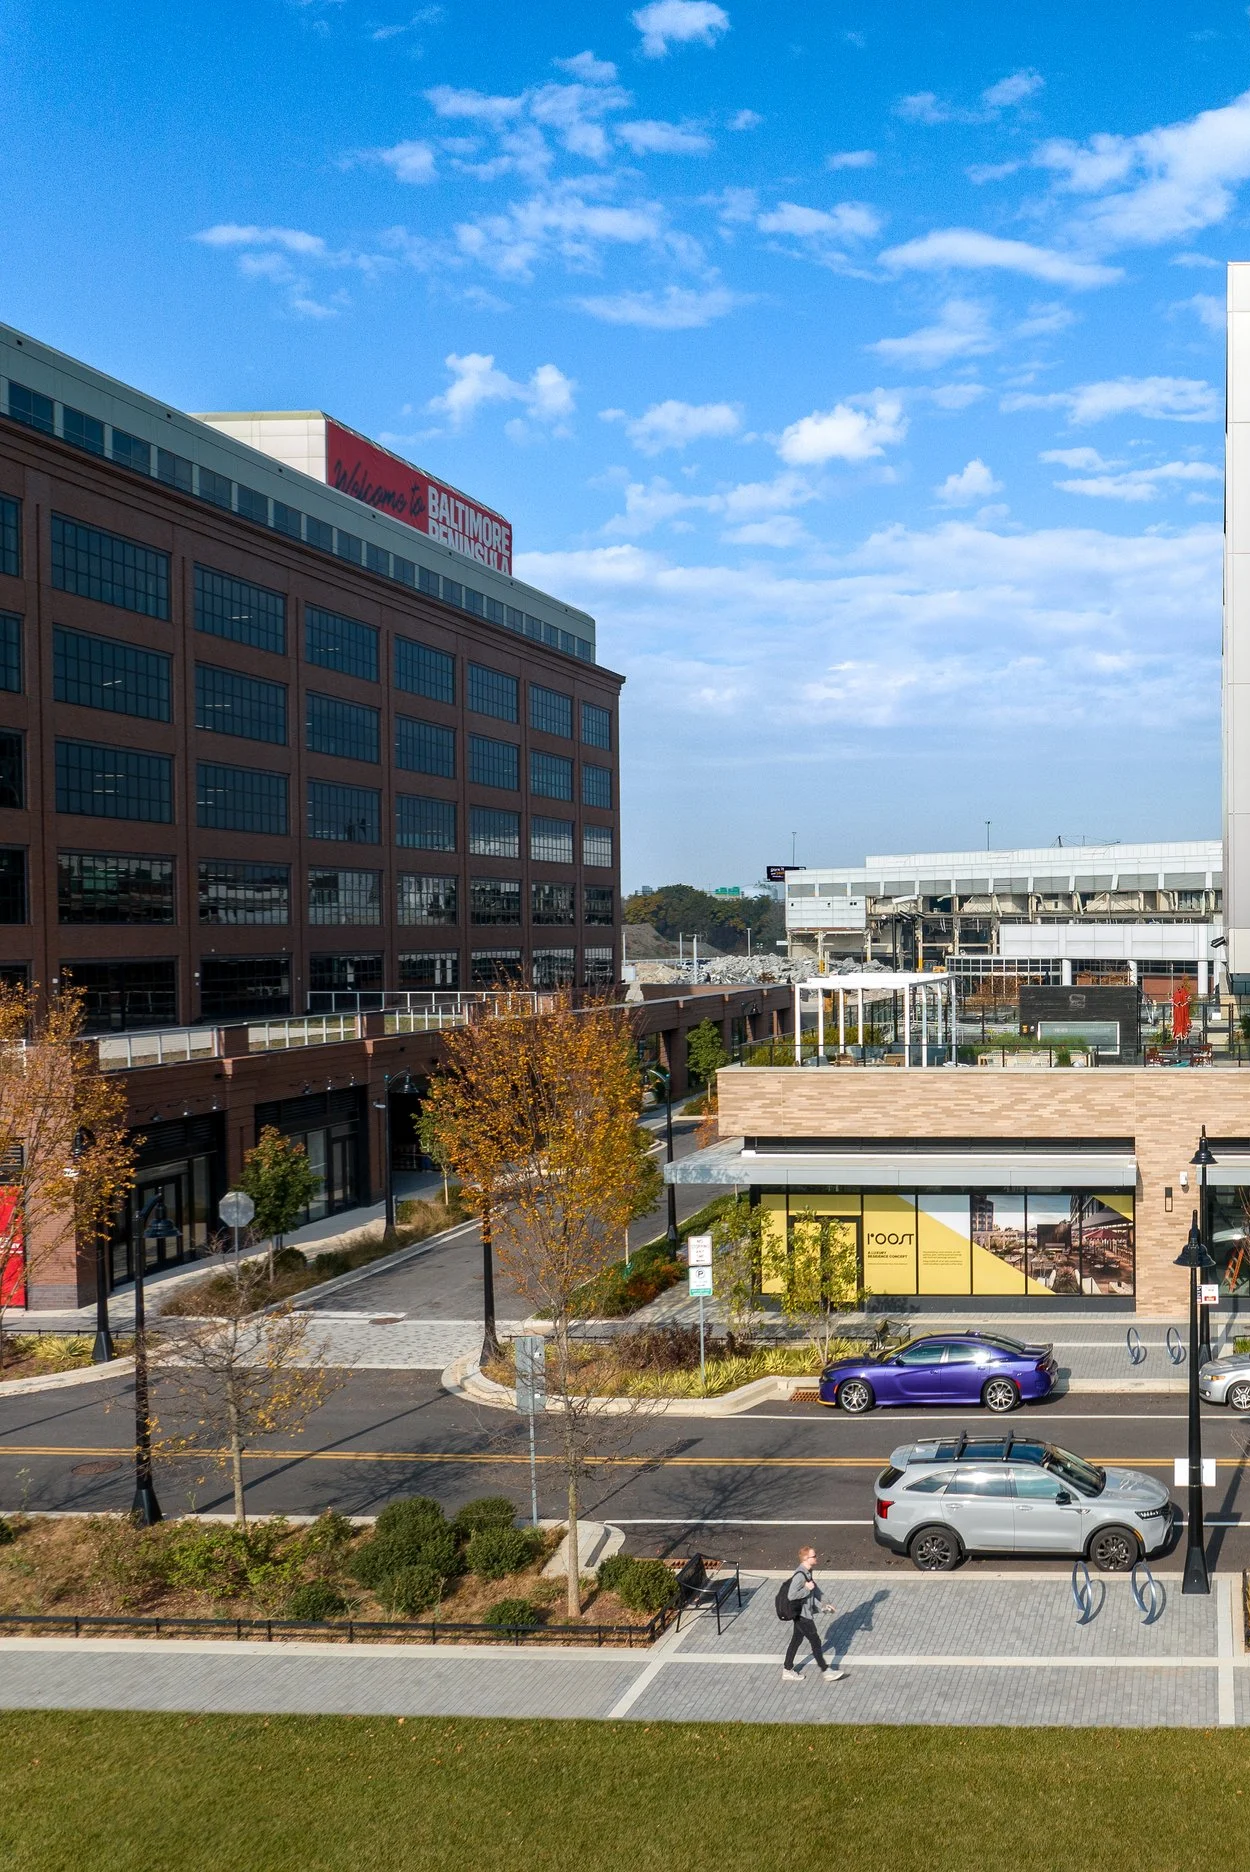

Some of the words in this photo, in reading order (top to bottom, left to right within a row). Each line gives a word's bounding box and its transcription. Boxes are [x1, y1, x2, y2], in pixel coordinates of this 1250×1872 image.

[334, 460, 407, 514] Welcome
[410, 484, 426, 518] to
[428, 485, 512, 558] BALTIMORE
